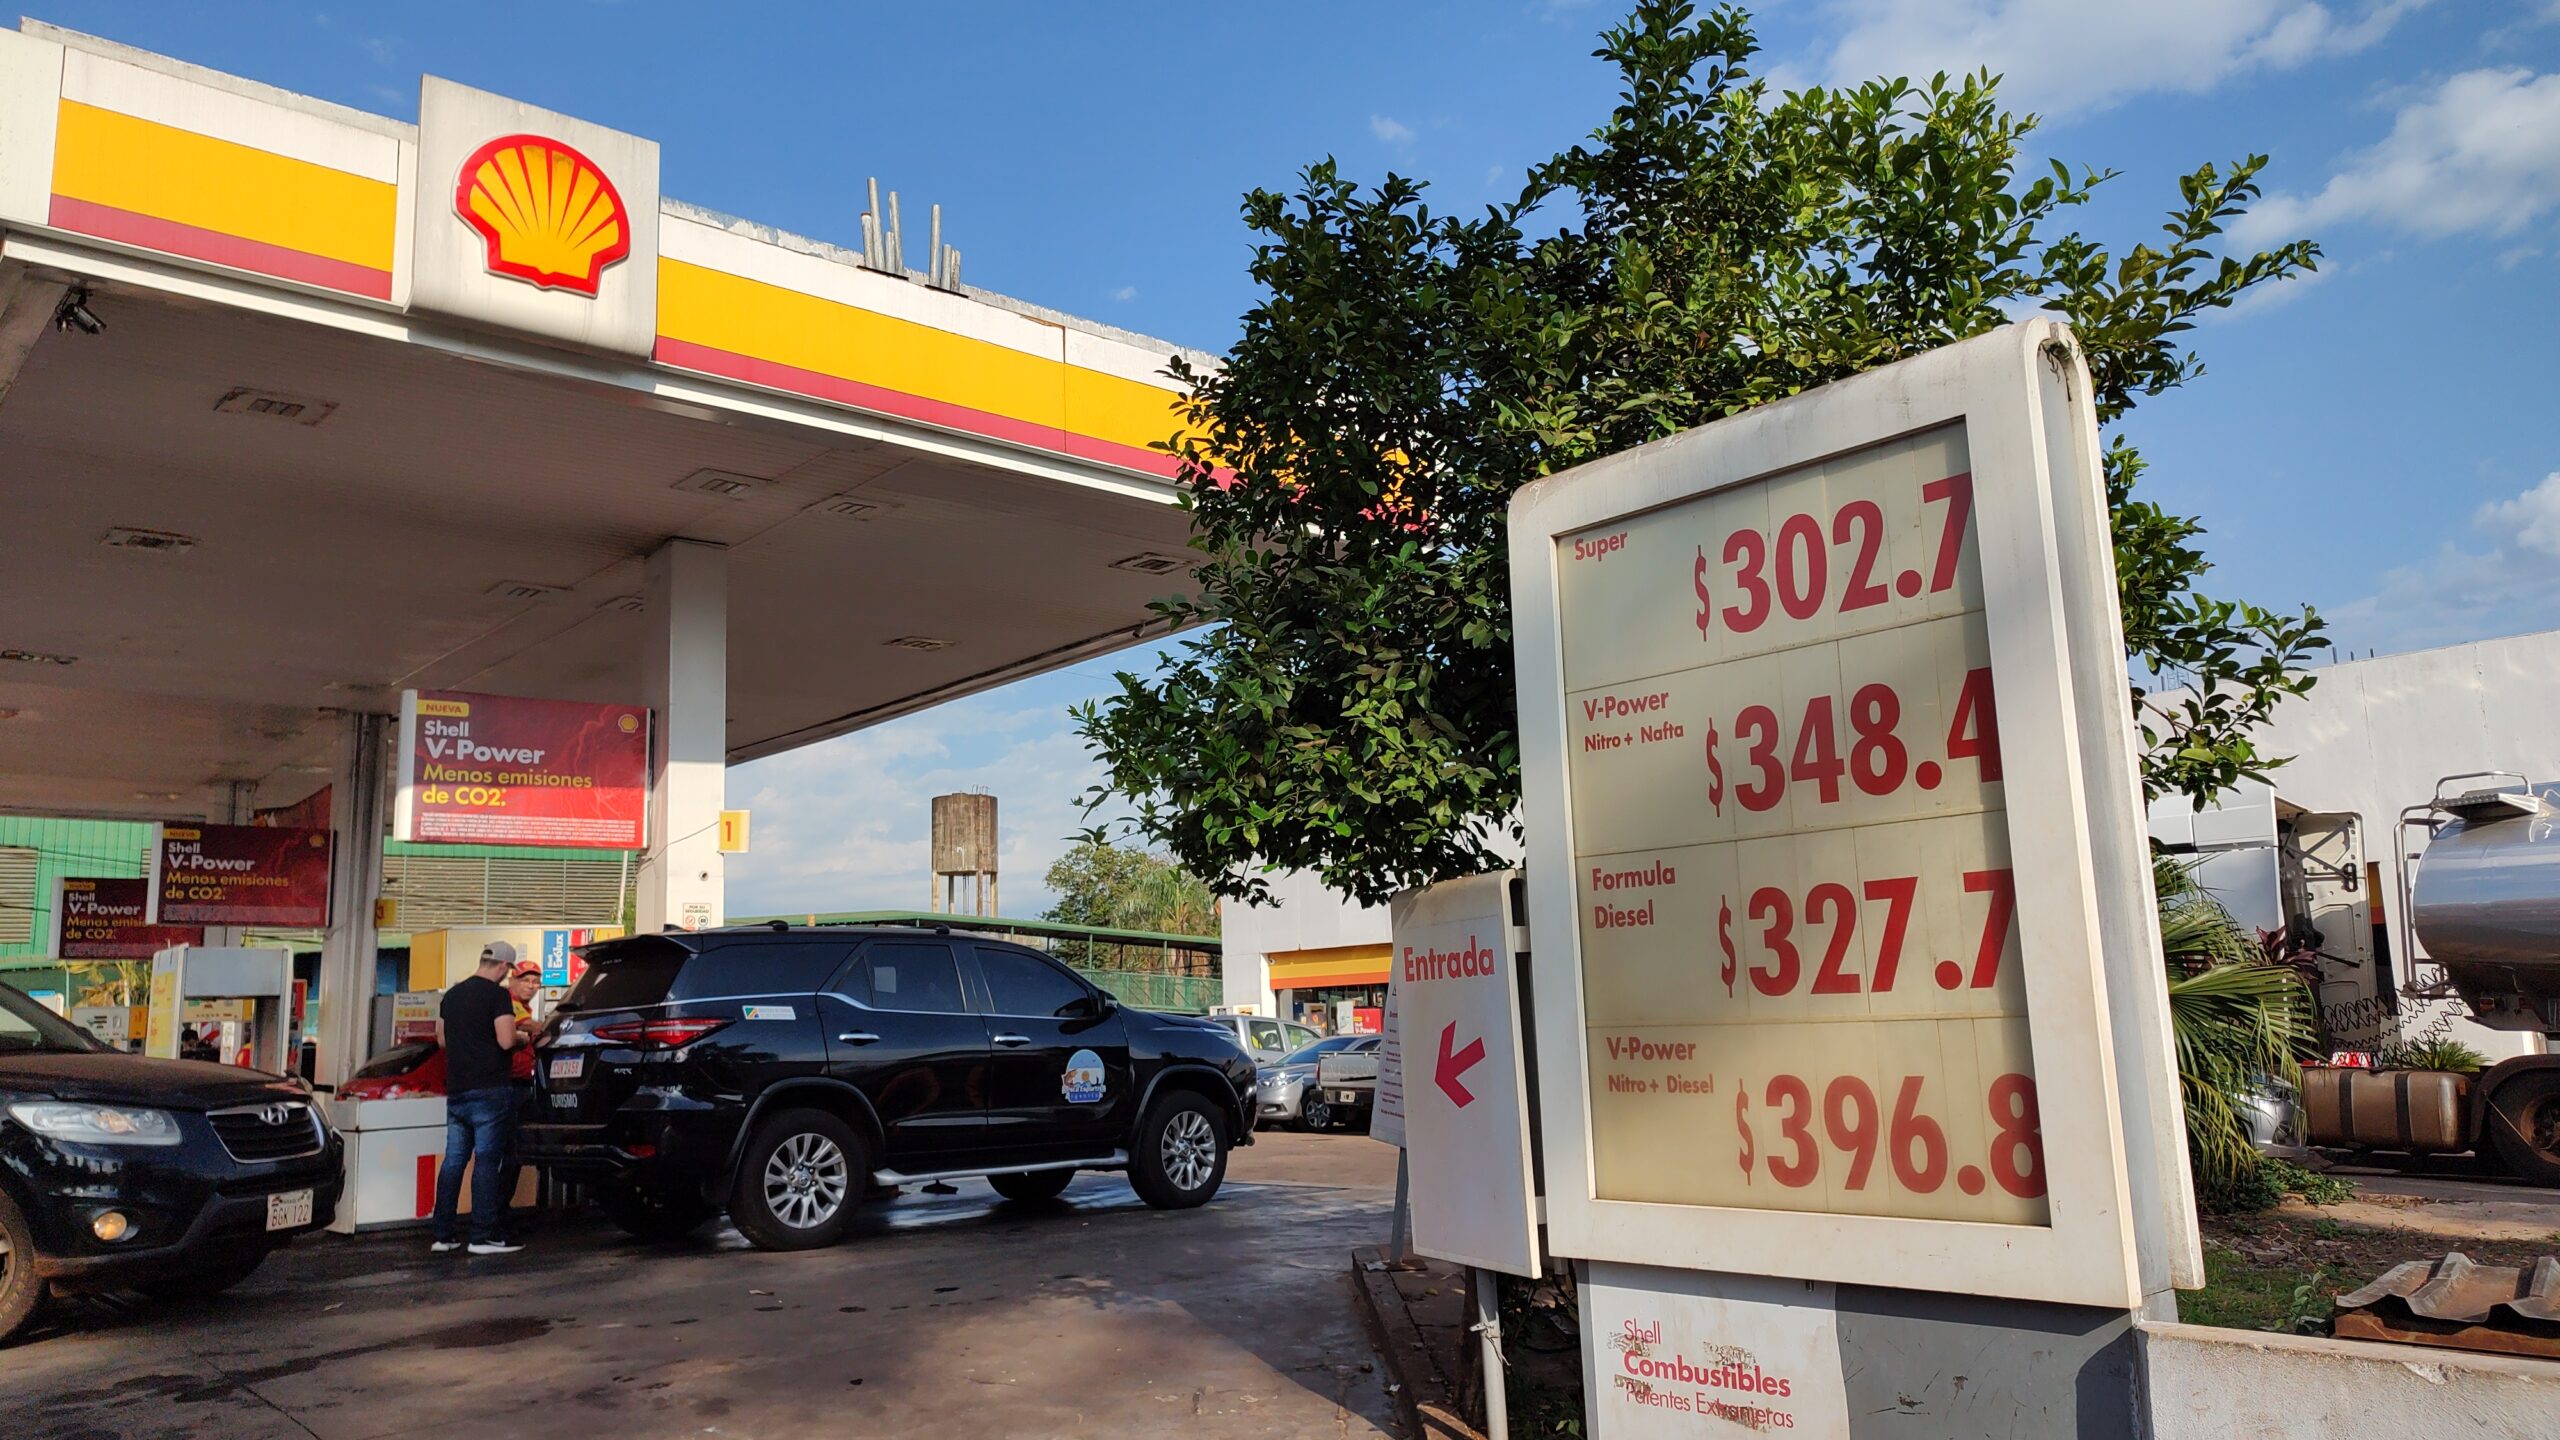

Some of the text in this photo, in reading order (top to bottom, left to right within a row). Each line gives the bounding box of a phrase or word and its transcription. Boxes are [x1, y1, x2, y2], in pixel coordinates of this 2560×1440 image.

[1574, 531, 1628, 561] Super
[425, 703, 462, 715] NUEVA
[1583, 691, 1669, 721] V-Power
[424, 719, 469, 738] Shell
[1640, 721, 1684, 743] Nafta
[424, 737, 545, 764] V-Power
[422, 763, 592, 788] Menos emisiones
[422, 784, 449, 805] de
[725, 820, 731, 842] 1
[168, 842, 200, 854] Shell
[168, 854, 255, 872] V-Power
[166, 872, 289, 888] Menos emisiones
[1592, 860, 1676, 891] Formula
[68, 892, 95, 902] Shell
[165, 886, 184, 900] de
[69, 902, 141, 916] V-Power
[1594, 906, 1655, 930] Diesel
[67, 917, 109, 927] Menos
[66, 929, 82, 940] de
[1403, 935, 1495, 983] Entrada
[1606, 1036, 1697, 1061] V-Power
[1666, 1072, 1714, 1095] Diesel
[550, 1093, 578, 1109] TURISMO
[1624, 1317, 1661, 1345] Shell
[1623, 1350, 1792, 1398] Combustibles
